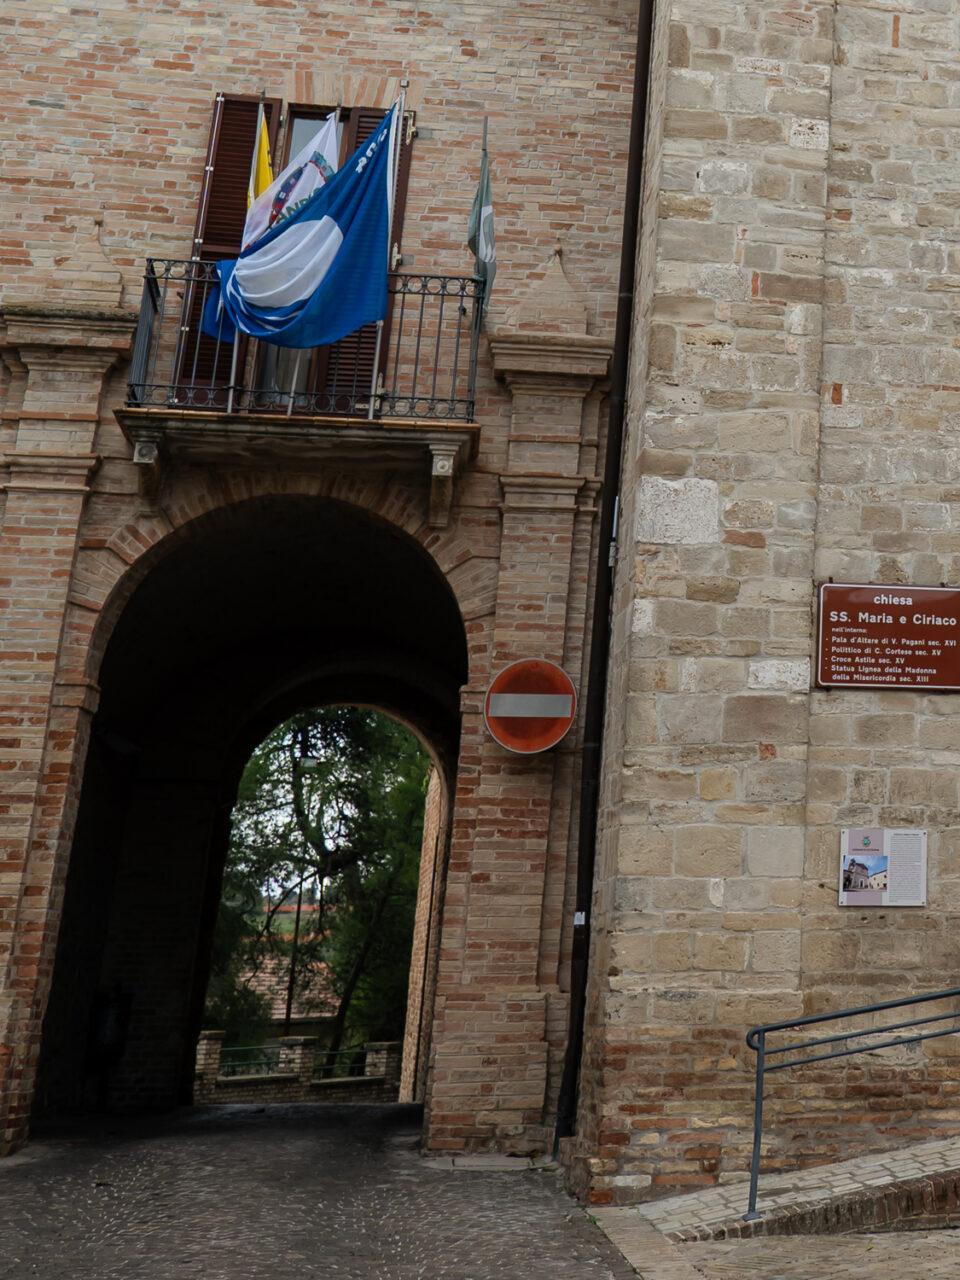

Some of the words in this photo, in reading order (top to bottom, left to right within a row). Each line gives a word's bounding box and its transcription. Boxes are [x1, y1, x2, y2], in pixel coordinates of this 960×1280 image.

[873, 593, 913, 606] chiesa
[830, 610, 851, 623] SS.
[858, 611, 893, 624] Maria
[899, 616, 907, 624] e
[912, 613, 957, 626] Ciriaco
[831, 635, 848, 643] Pala
[850, 636, 879, 644] d'Altare
[881, 637, 889, 645] di
[901, 638, 925, 647] Pagani
[944, 639, 957, 647] XVI
